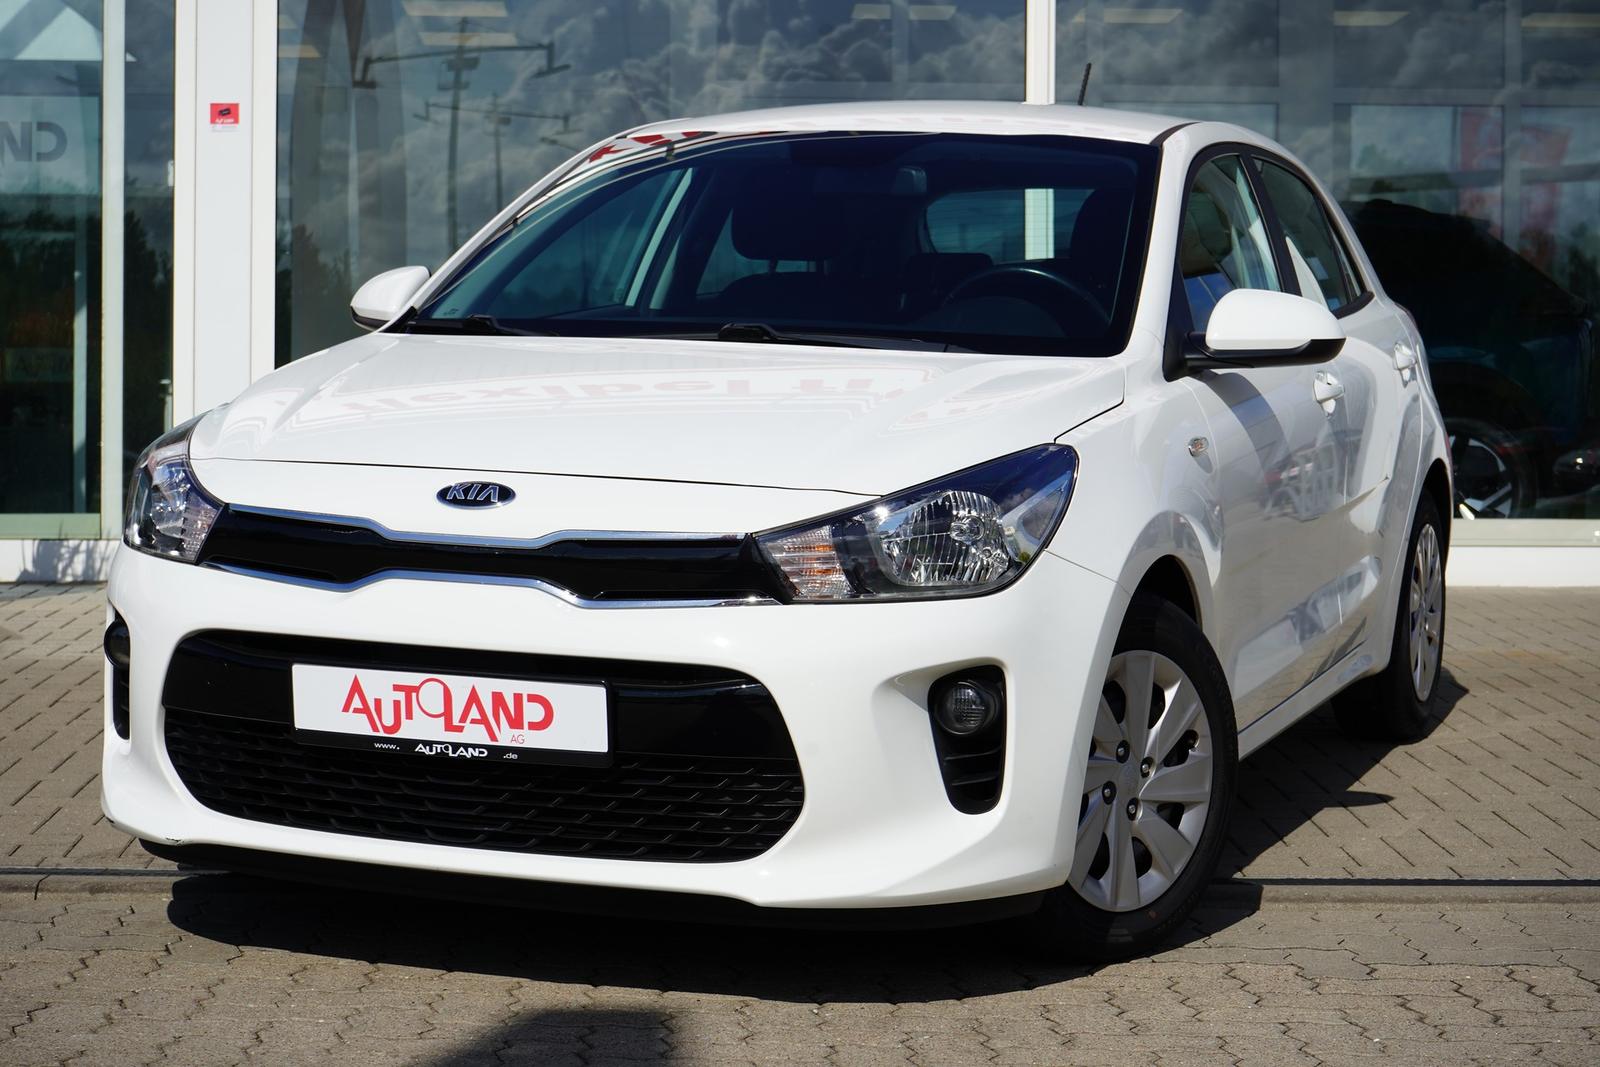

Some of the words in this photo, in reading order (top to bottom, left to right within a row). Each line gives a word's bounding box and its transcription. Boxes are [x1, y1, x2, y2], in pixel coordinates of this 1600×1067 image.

[446, 483, 499, 503] KIA
[510, 733, 526, 745] AG
[374, 742, 400, 750] www.
[503, 752, 518, 760] .de
